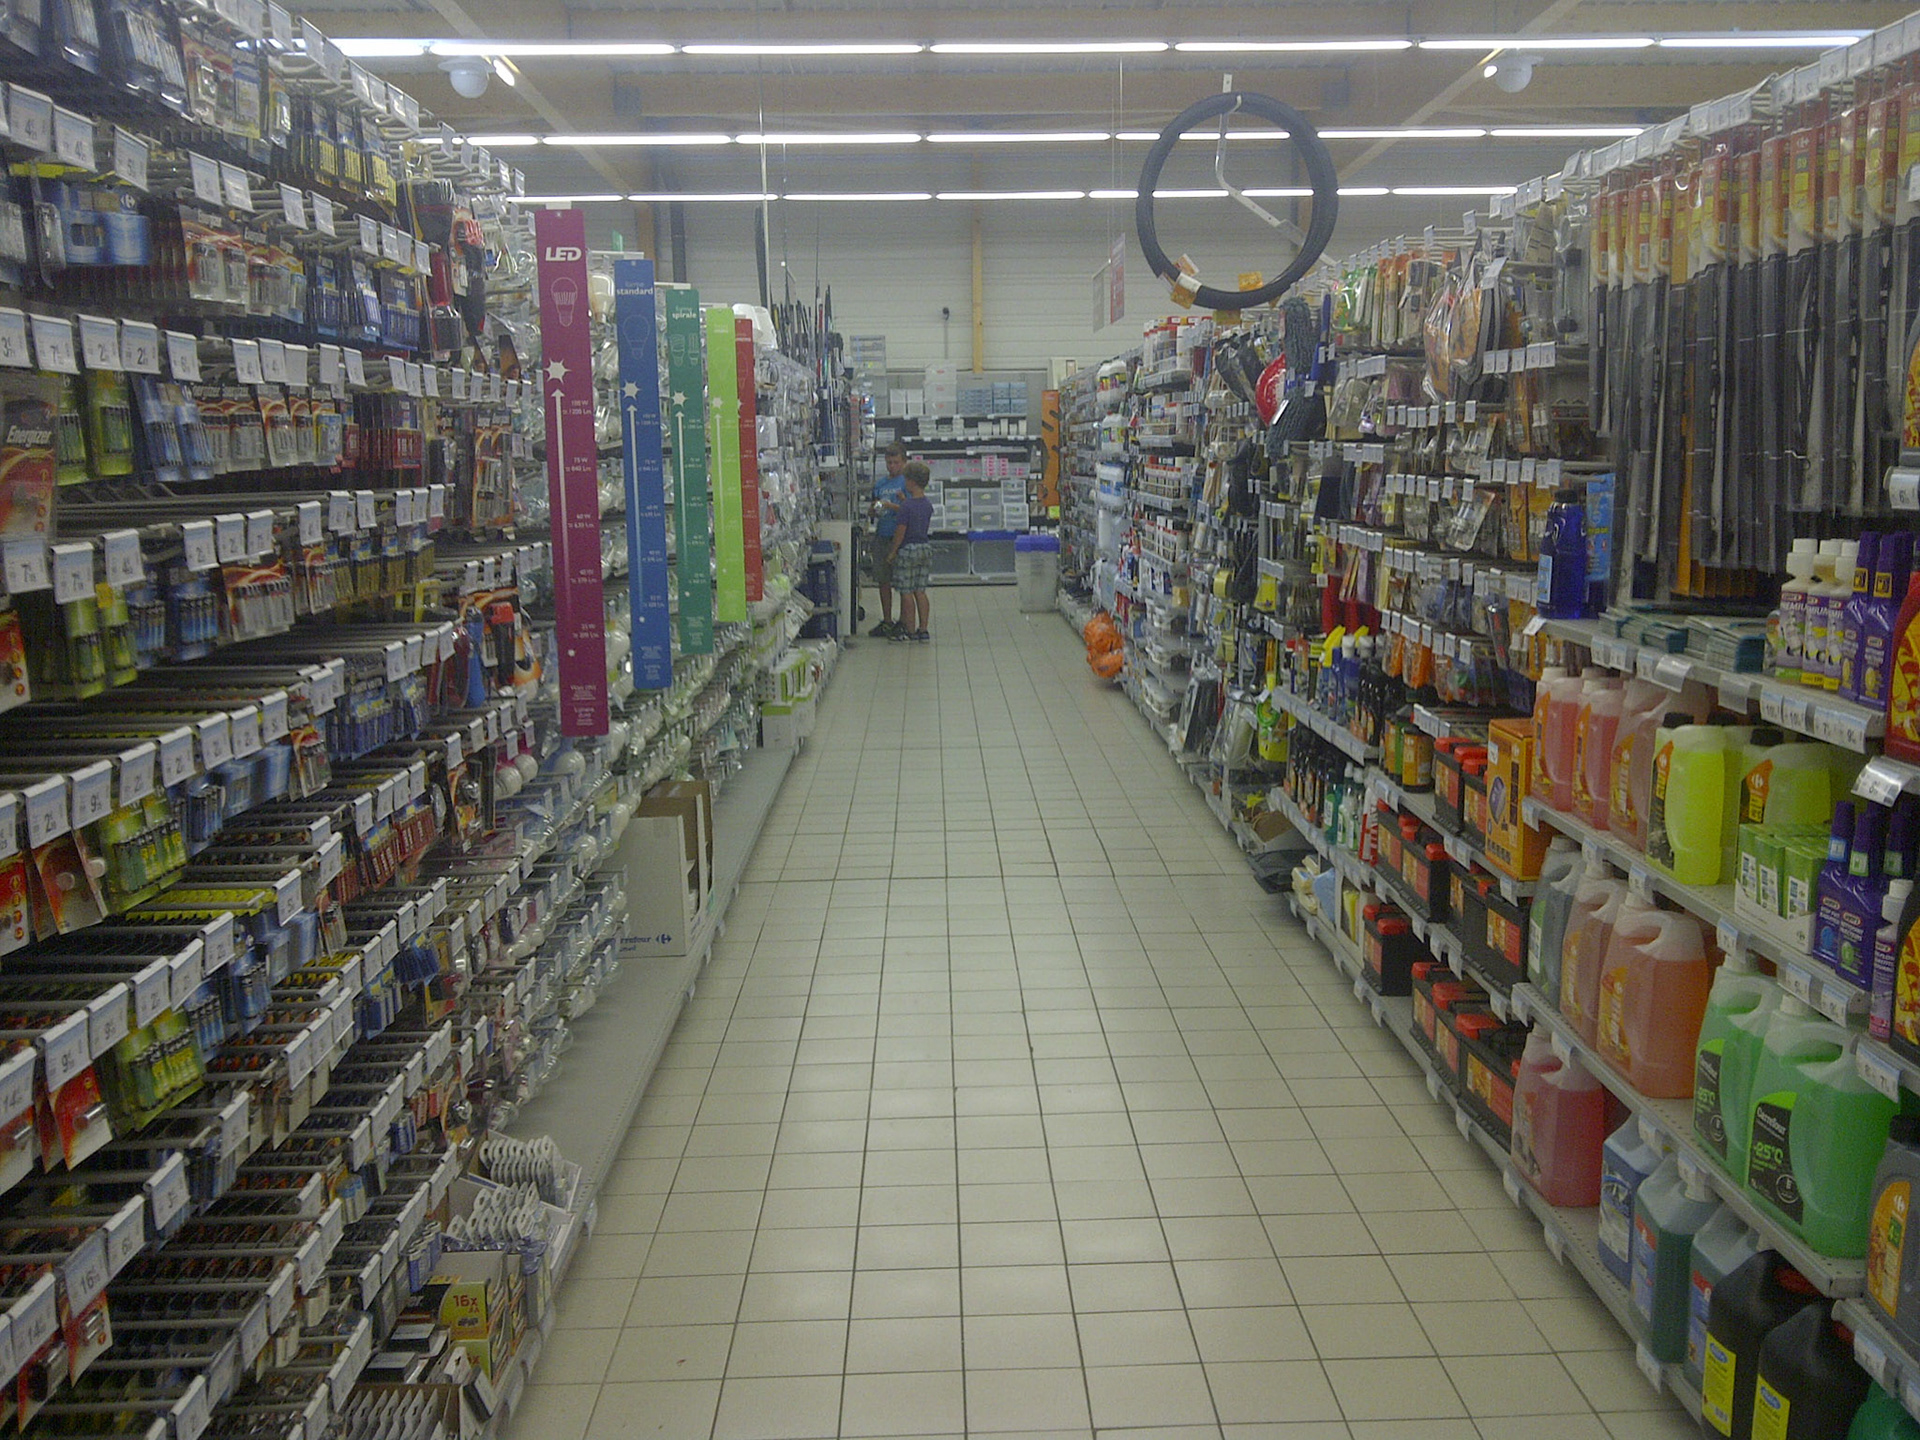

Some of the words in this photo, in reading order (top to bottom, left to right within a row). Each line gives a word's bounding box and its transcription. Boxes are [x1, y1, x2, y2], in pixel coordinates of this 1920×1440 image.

[545, 246, 582, 262] LED
[616, 287, 654, 296] standard
[671, 311, 697, 320] spirale
[6, 425, 52, 448] Energizer
[620, 936, 652, 944] rrefour
[1756, 1107, 1787, 1135] Carrefour
[453, 1295, 478, 1307] 16x
